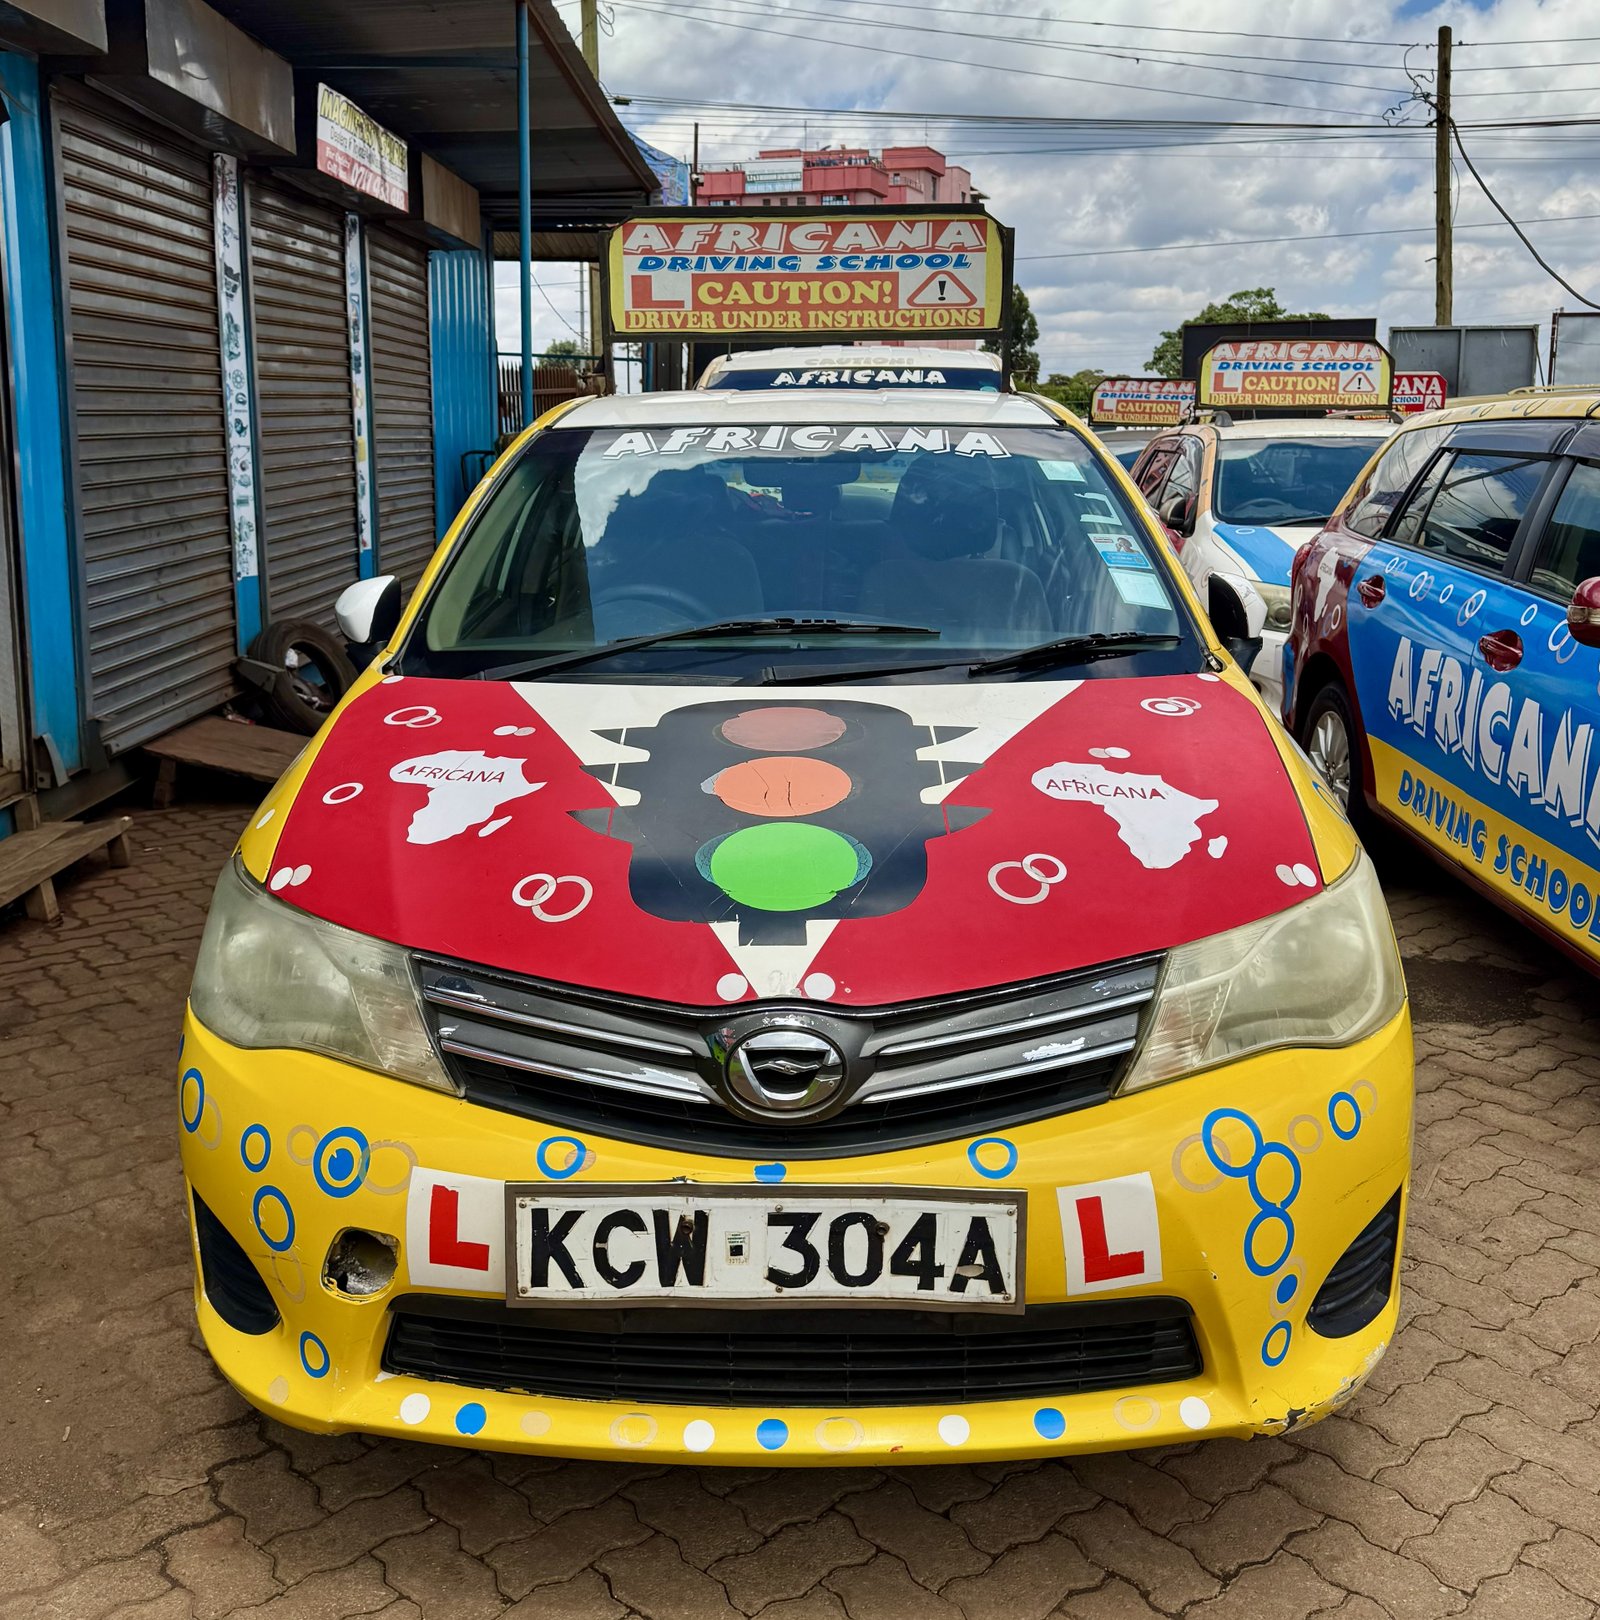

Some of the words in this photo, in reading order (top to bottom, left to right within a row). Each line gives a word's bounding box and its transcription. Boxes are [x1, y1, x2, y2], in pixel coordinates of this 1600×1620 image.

[623, 221, 987, 254] AFRICANA
[637, 255, 801, 272] DRIVING
[816, 253, 972, 271] SCHOOL
[697, 280, 892, 305] CAUTION!
[628, 310, 718, 329] DRIVER
[721, 310, 802, 329] UNDER
[807, 309, 981, 329] INSTRUCTIONS
[1212, 342, 1382, 361] AFRICANA
[804, 357, 914, 366] CAUTION!
[1217, 361, 1295, 371] DRIVING
[1301, 361, 1374, 371] SCHOOL
[770, 369, 947, 386] AFRICANA
[1097, 381, 1195, 393] AFRICAN
[1244, 376, 1337, 391] CAUTION!
[1117, 402, 1179, 413] CAUTION!
[1211, 393, 1252, 405] DRIVER
[1255, 393, 1293, 405] UNDER
[1295, 393, 1377, 405] INSTRUCTIONS
[1124, 413, 1147, 421] UNDER
[602, 425, 1012, 460] AFRICANA
[398, 765, 505, 783] AFRICANA
[1046, 779, 1166, 800] AFRICANA
[1398, 770, 1487, 862] DRIVING
[429, 1184, 490, 1272] L
[1075, 1195, 1145, 1284] L
[530, 1208, 713, 1290] KCW
[767, 1210, 1007, 1295] 304A
